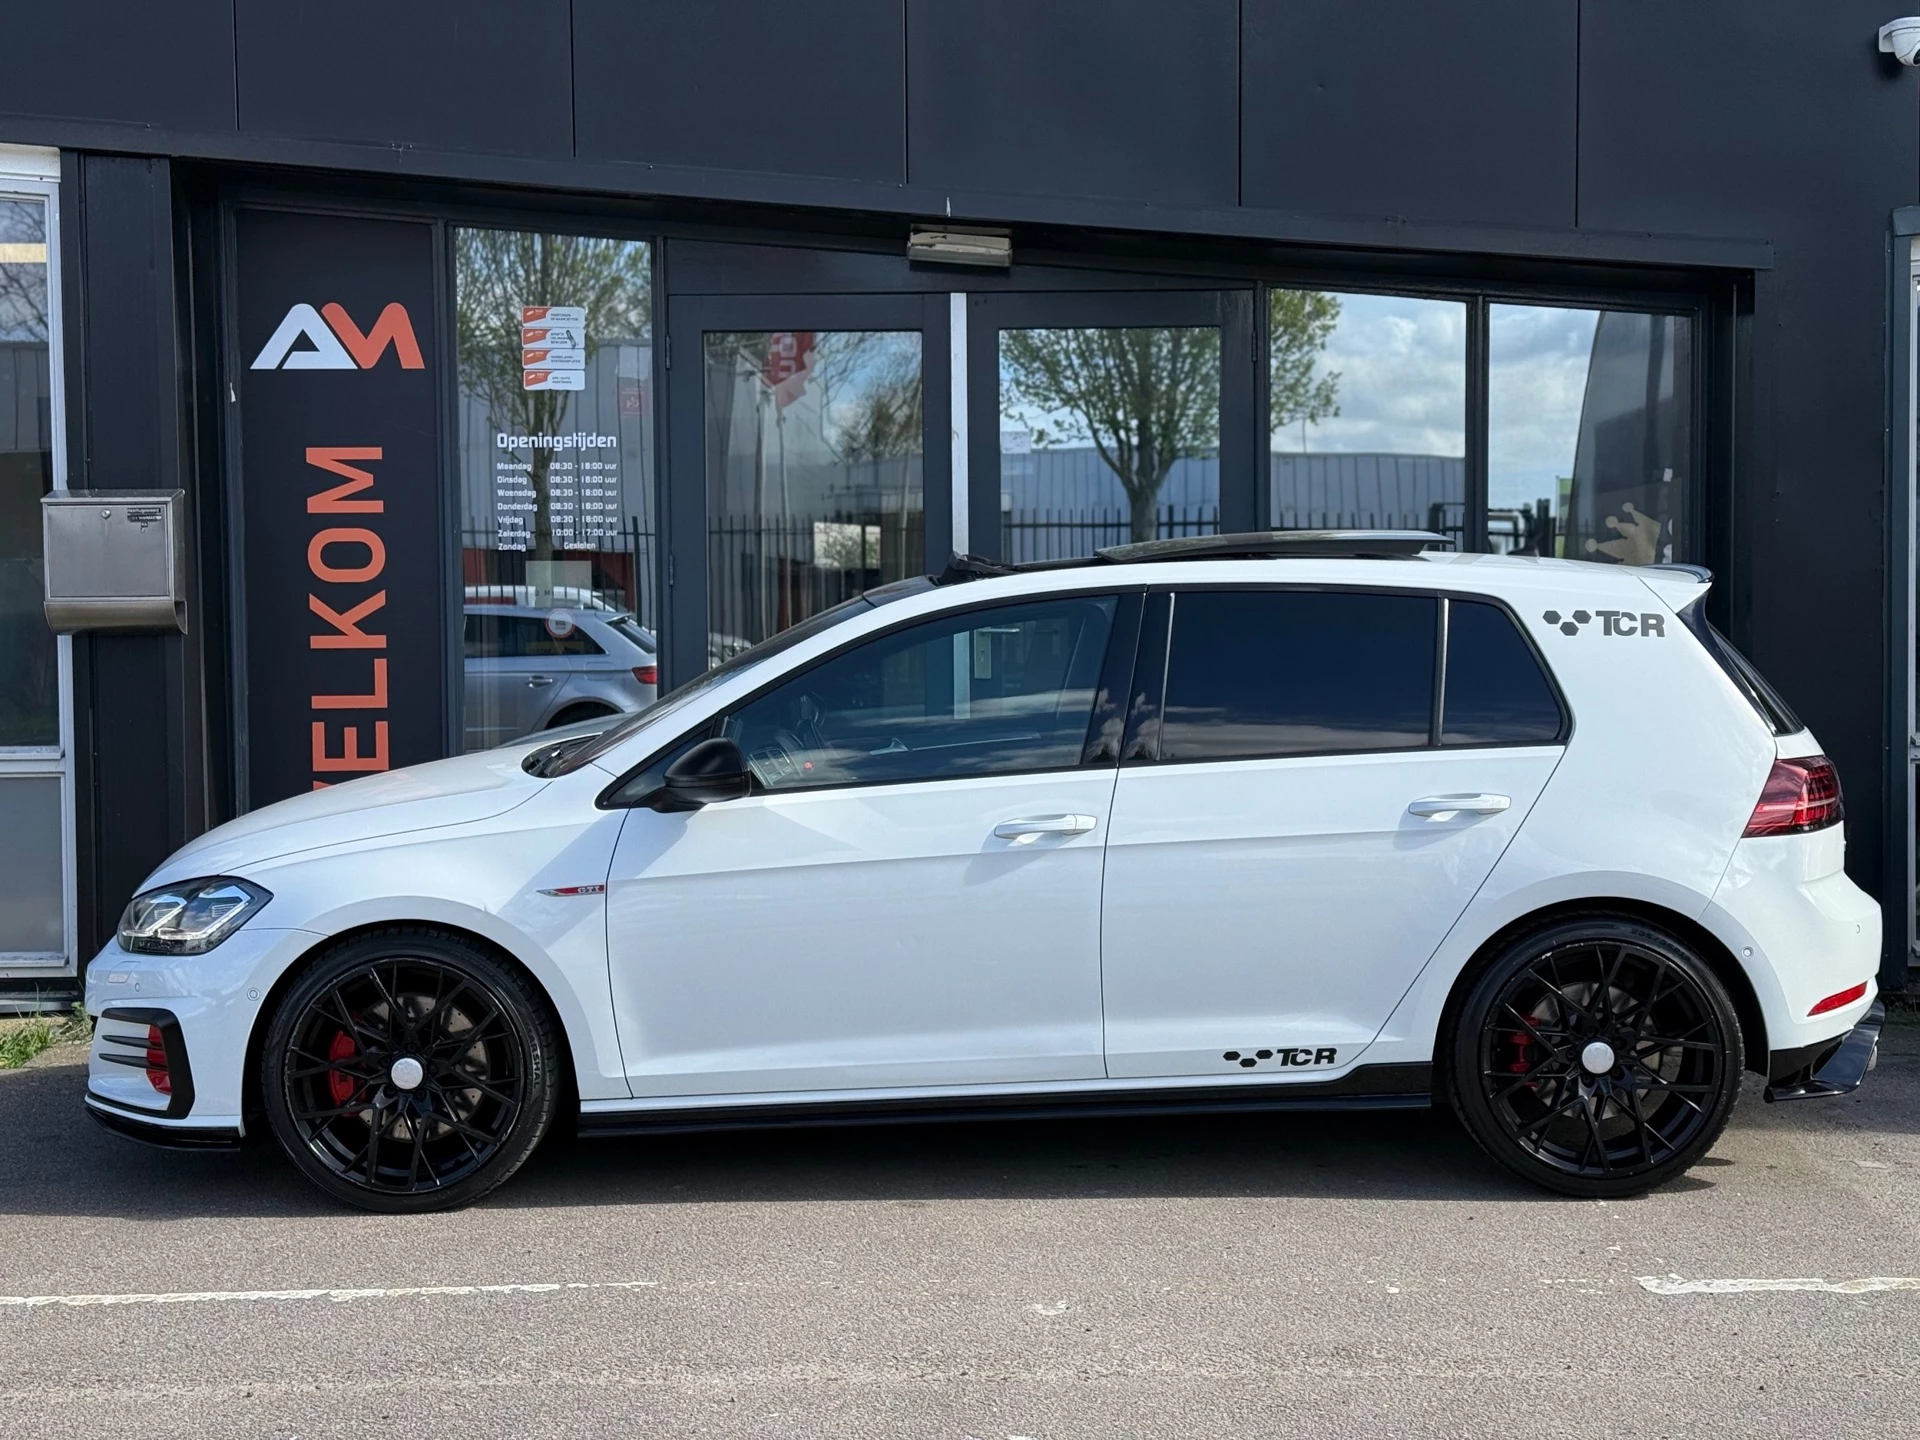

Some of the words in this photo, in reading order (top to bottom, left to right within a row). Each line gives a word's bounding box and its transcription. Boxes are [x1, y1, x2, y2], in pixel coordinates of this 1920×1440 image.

[497, 432, 617, 452] Openingstijden
[496, 462, 532, 472] Maandag
[497, 476, 527, 485] Dinsdag
[497, 489, 537, 498] Woensdag
[497, 503, 538, 512] Donderdag
[550, 502, 573, 510] 08:30
[581, 502, 603, 510] 18:00
[497, 516, 524, 525] Vrijdag
[550, 515, 573, 523] 08:30
[581, 515, 603, 523] 18:00
[498, 529, 531, 538] Zaterdag
[498, 543, 527, 552] Zondag
[563, 541, 596, 550] Gesloten
[305, 446, 390, 791] ELKOM
[1595, 610, 1665, 637] TCR
[577, 886, 600, 894] GTI
[525, 1021, 542, 1090] MARSHAL
[1276, 1047, 1337, 1067] TCR
